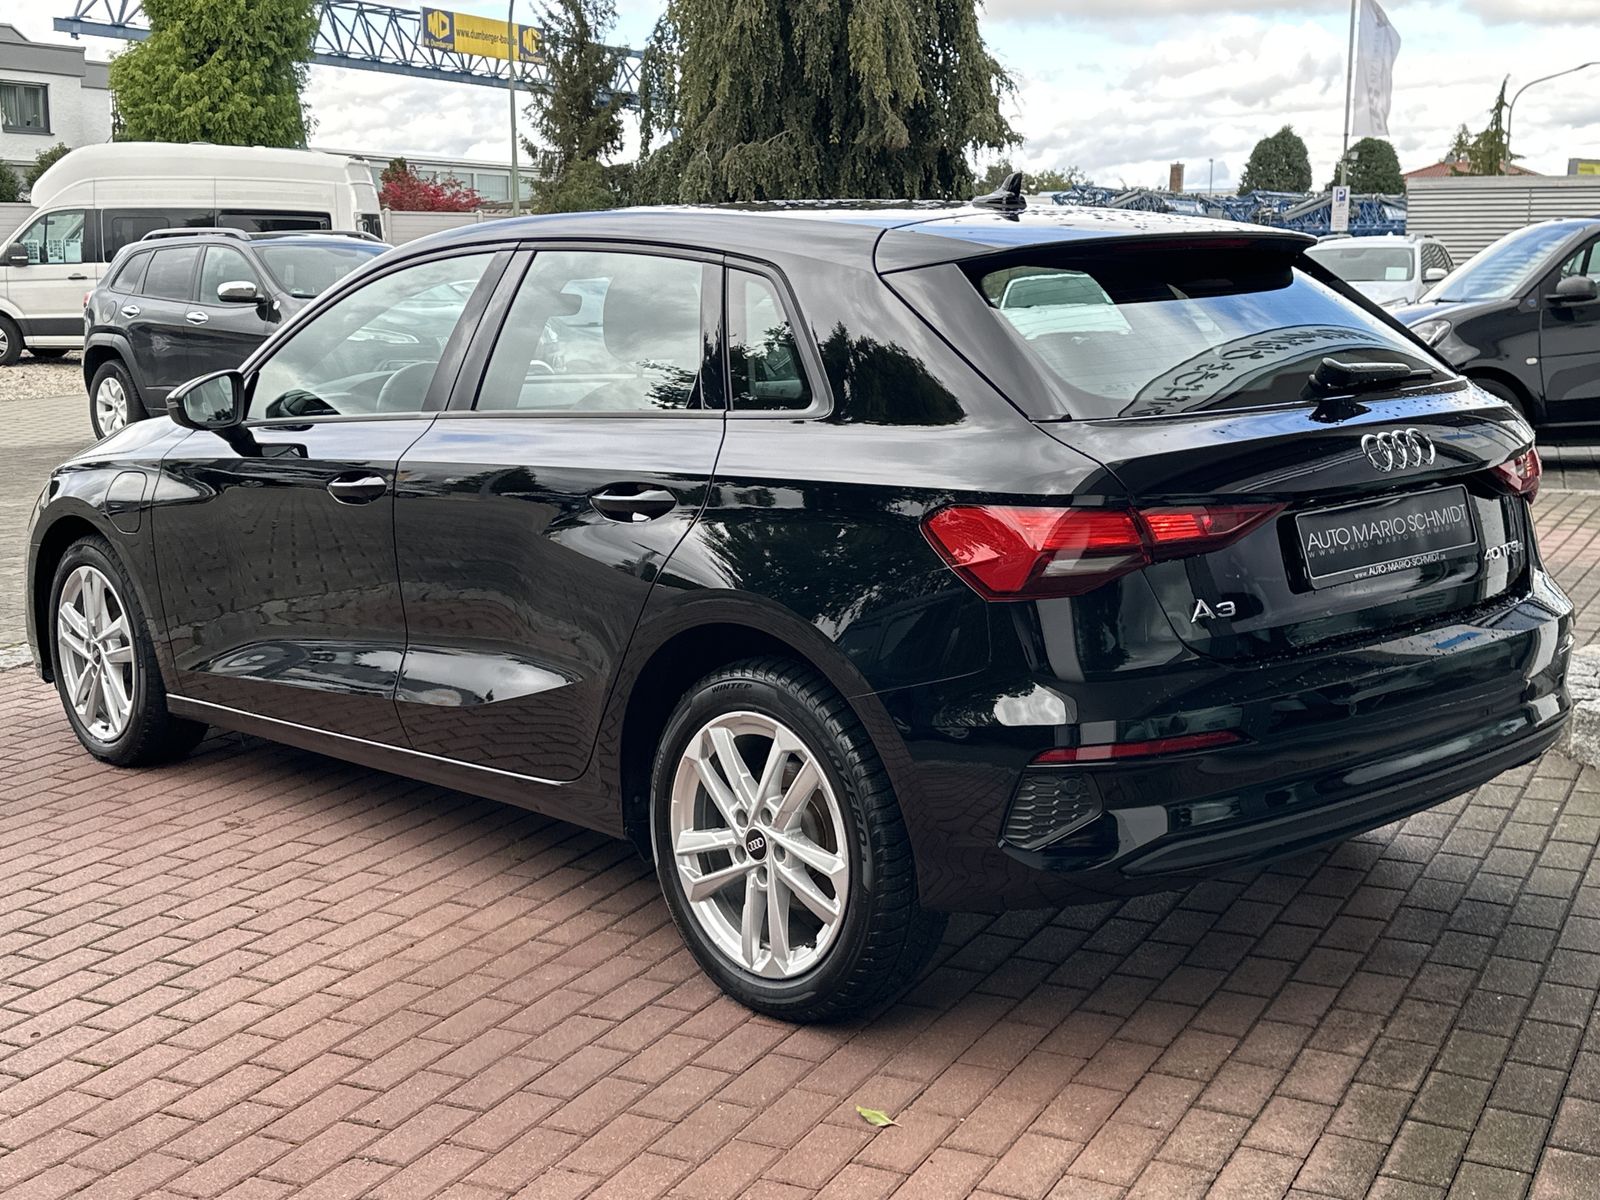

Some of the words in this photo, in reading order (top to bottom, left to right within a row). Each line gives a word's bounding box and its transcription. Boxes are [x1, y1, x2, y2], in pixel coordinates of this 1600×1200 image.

[1307, 527, 1351, 551] AUTO
[1352, 517, 1406, 543] MARIO
[1406, 503, 1468, 532] SCHMIDT
[1191, 599, 1236, 623] A3
